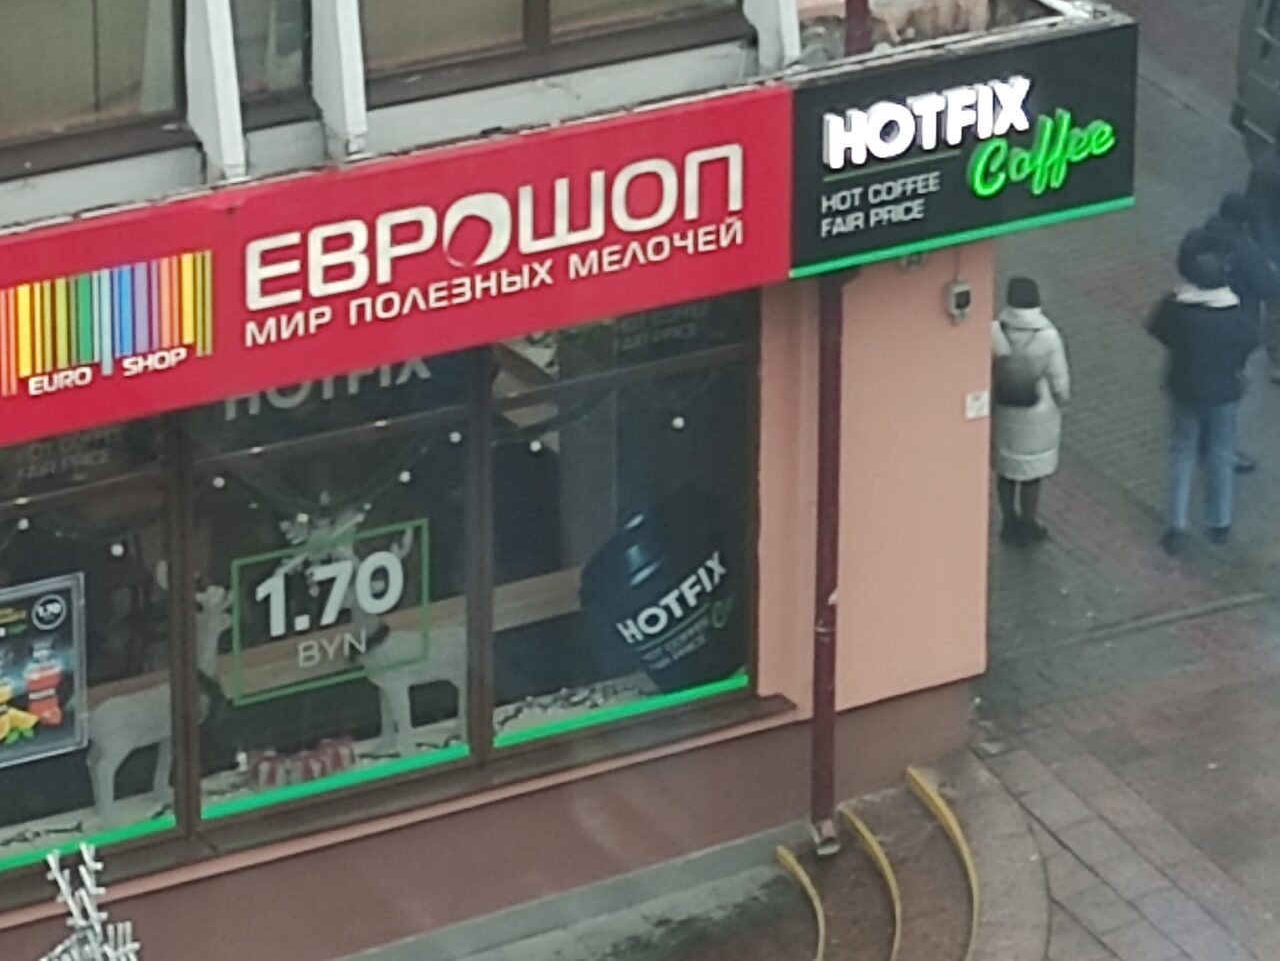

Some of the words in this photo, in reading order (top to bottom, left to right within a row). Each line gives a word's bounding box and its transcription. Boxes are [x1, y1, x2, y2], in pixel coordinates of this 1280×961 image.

[822, 75, 1031, 169] HOTFIX
[967, 107, 1115, 197] Coffee
[245, 143, 743, 311] ЕВРОШОП
[821, 188, 863, 213] HOT
[868, 171, 941, 203] COFFEE
[821, 214, 865, 238] FAIR
[870, 199, 925, 227] PRICE
[244, 305, 333, 348] МИР
[349, 259, 554, 326] ПОЛЕЗНЫХ
[568, 215, 744, 281] МЕЛОЧЕЙ
[28, 366, 93, 396] EURO
[122, 347, 188, 377] SHOP
[255, 551, 404, 637] 1.70
[616, 550, 726, 644] HOTFIX
[298, 626, 366, 668] BYN
